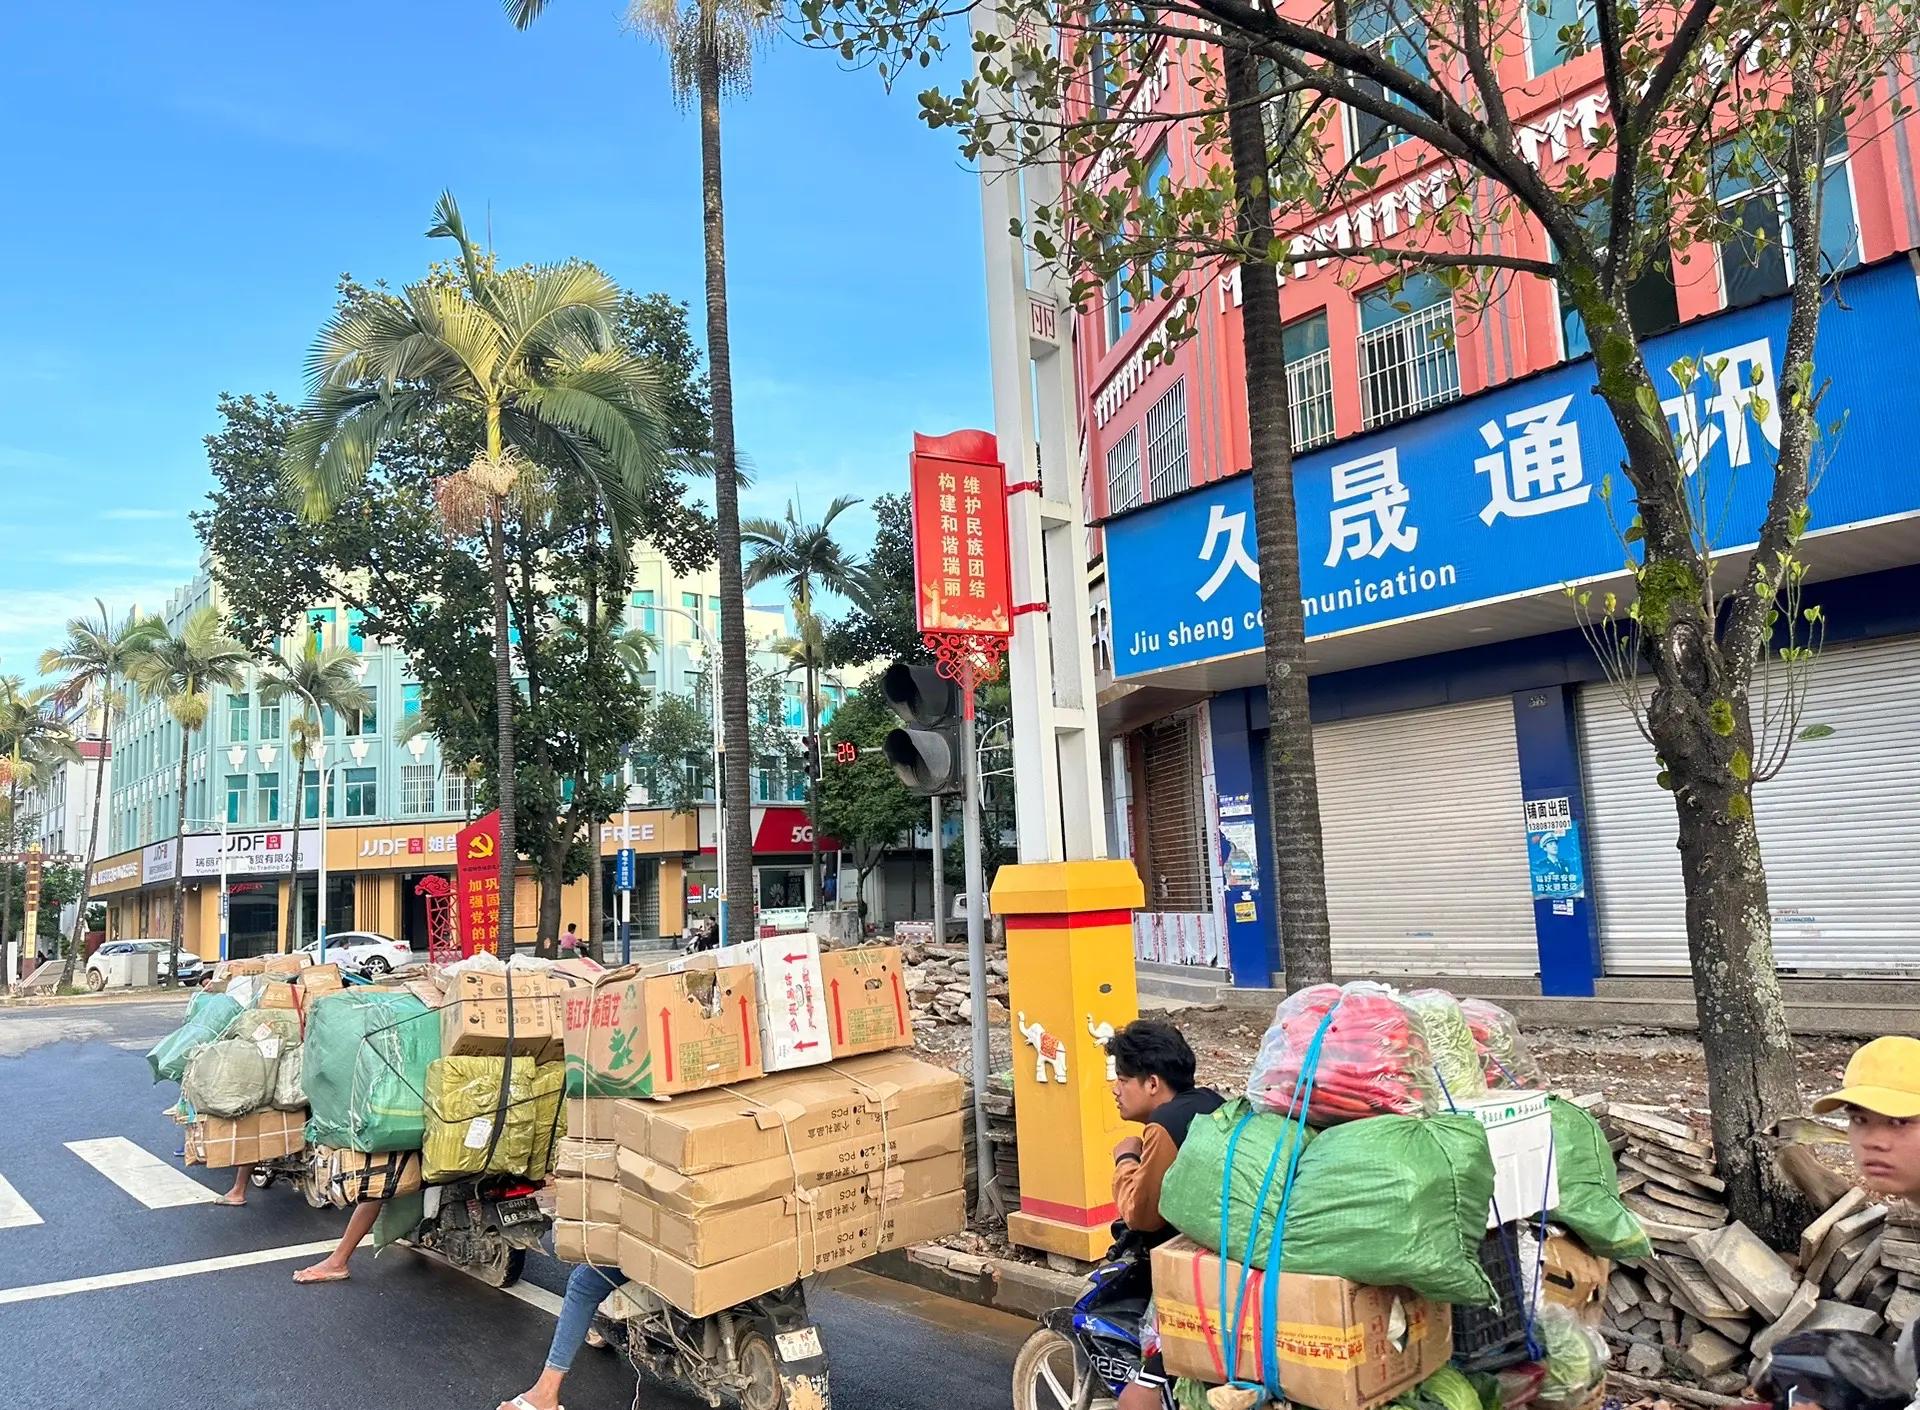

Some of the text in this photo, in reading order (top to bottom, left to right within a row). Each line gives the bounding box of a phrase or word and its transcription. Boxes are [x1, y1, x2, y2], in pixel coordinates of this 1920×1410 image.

[1029, 297, 1056, 339] 丽
[1196, 337, 1781, 603] 久晟通讯
[938, 472, 961, 597] 构建和谐瑞丽
[963, 476, 985, 599] 维护民族团结
[1129, 563, 1457, 656] Jiu sheng comunication
[1527, 799, 1569, 819] 铺面出租
[600, 824, 655, 843] FREE
[790, 826, 814, 844] 5G
[217, 835, 265, 852] JDF
[359, 837, 408, 857] JJDF
[831, 1107, 849, 1119] PCS
[838, 1151, 856, 1163] PCS
[839, 1187, 856, 1200] PCS
[837, 1231, 854, 1243] PCS
